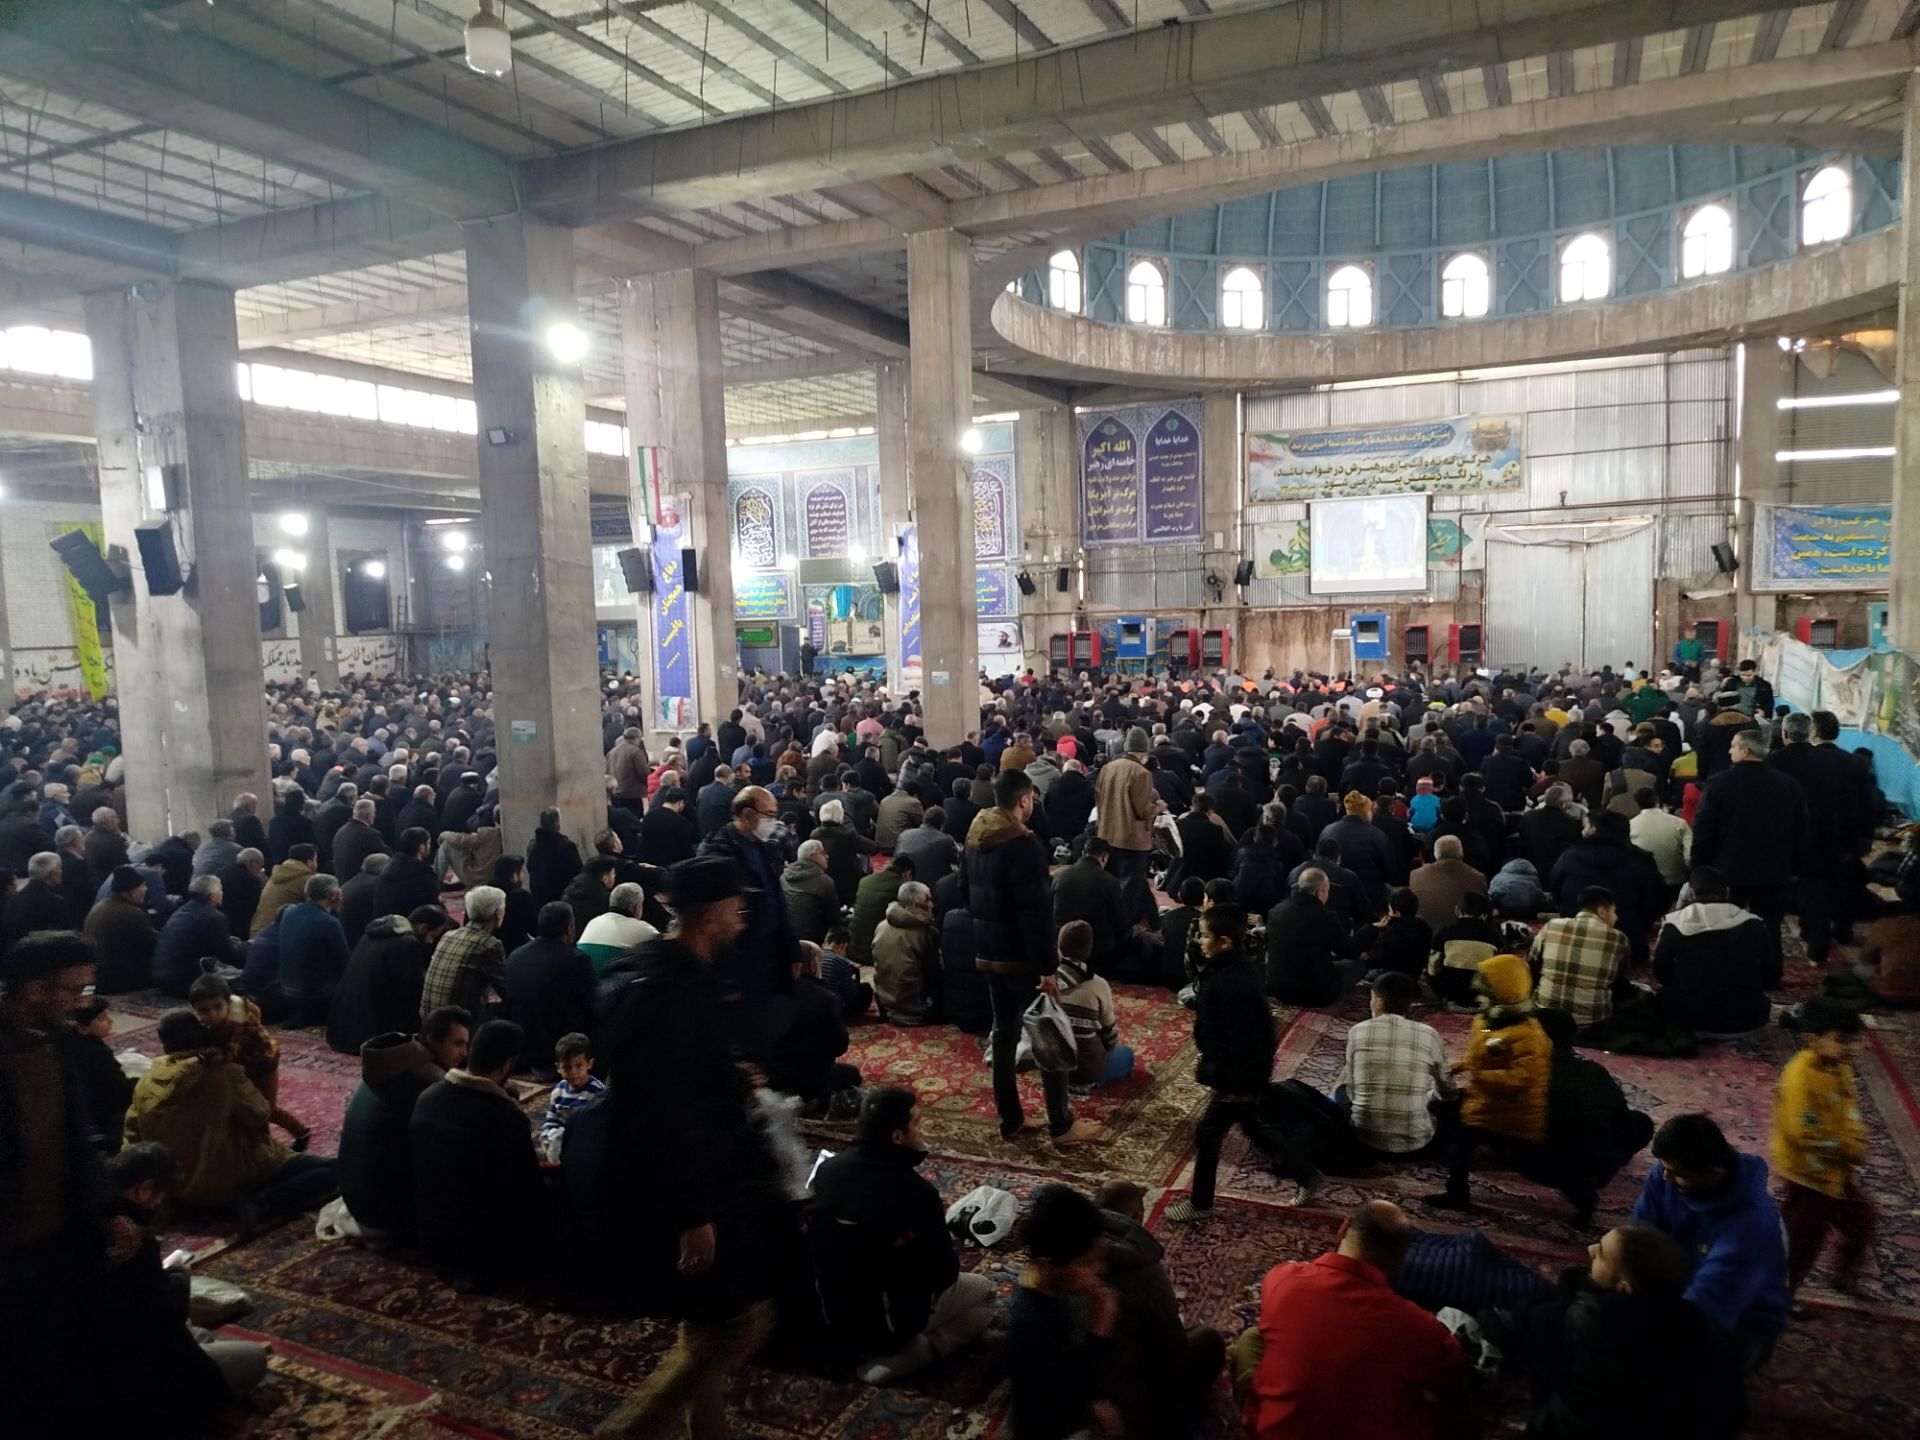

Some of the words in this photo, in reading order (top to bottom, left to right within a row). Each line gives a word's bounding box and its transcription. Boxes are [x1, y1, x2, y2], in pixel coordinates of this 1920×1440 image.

[1113, 440, 1130, 452] الله
[1155, 436, 1171, 446] خدایا
[1173, 435, 1189, 445] خدایا
[1091, 441, 1111, 458] اکبر
[1087, 460, 1104, 472] رهبر
[1115, 456, 1136, 467] خامنه
[1443, 456, 1457, 465] که
[1305, 465, 1333, 478] خواب
[1333, 465, 1344, 477] در
[1345, 462, 1386, 475] رهبرش
[1443, 469, 1467, 480] لگد
[1467, 471, 1484, 482] زیر
[1087, 486, 1112, 501] آمریکا
[1120, 487, 1136, 499] مرگ
[1122, 503, 1136, 515] مرگ
[1856, 546, 1889, 560] کرده
[662, 561, 677, 583] دفاع
[661, 584, 682, 616] همچنان
